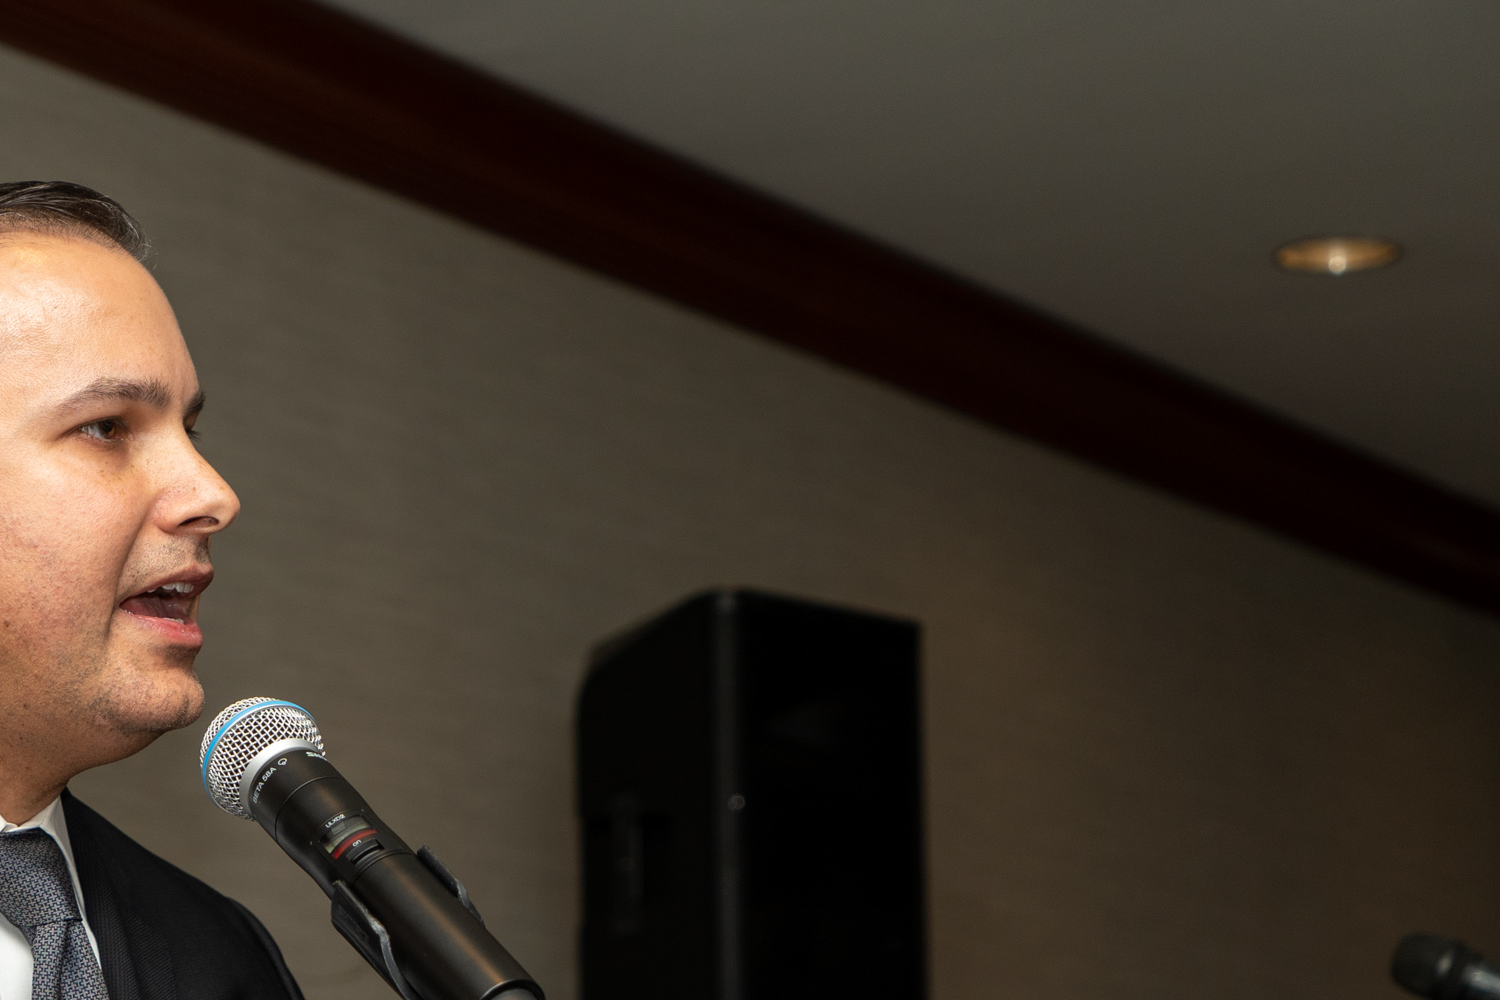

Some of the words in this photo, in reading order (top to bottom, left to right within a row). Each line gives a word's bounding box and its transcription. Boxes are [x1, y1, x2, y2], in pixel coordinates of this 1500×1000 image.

[253, 782, 264, 803] BETA
[262, 767, 276, 781] 58A
[352, 839, 361, 847] on
